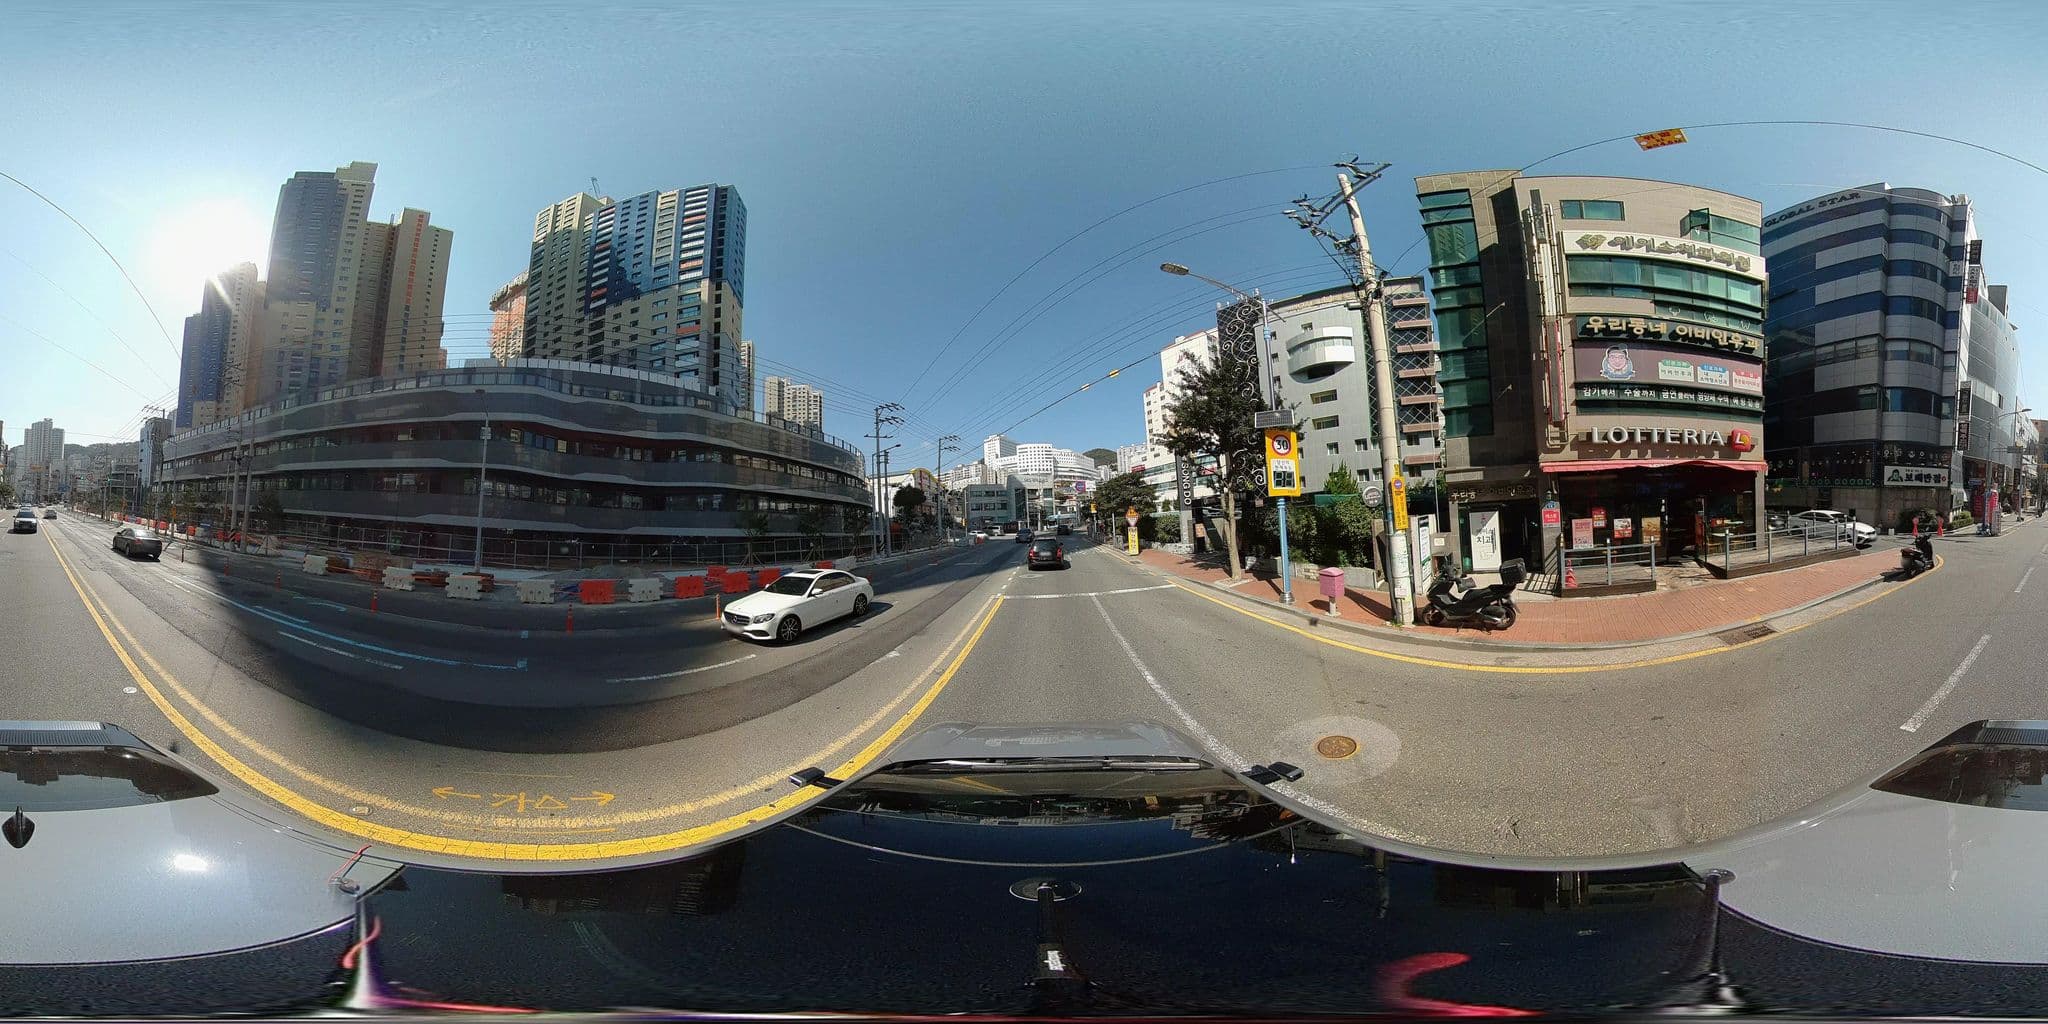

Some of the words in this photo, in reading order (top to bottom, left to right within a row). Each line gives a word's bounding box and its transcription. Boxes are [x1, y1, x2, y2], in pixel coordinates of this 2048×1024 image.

[1764, 205, 1815, 227] GLOBAL
[1818, 191, 1861, 208] STAR
[1586, 316, 1667, 335] 우리동네
[1675, 325, 1761, 350] 이비인후과
[1583, 386, 1616, 397] 감기에서
[1624, 387, 1656, 398] 수술까지
[1276, 439, 1289, 450] 30
[1591, 426, 1725, 446] LOTTERIA
